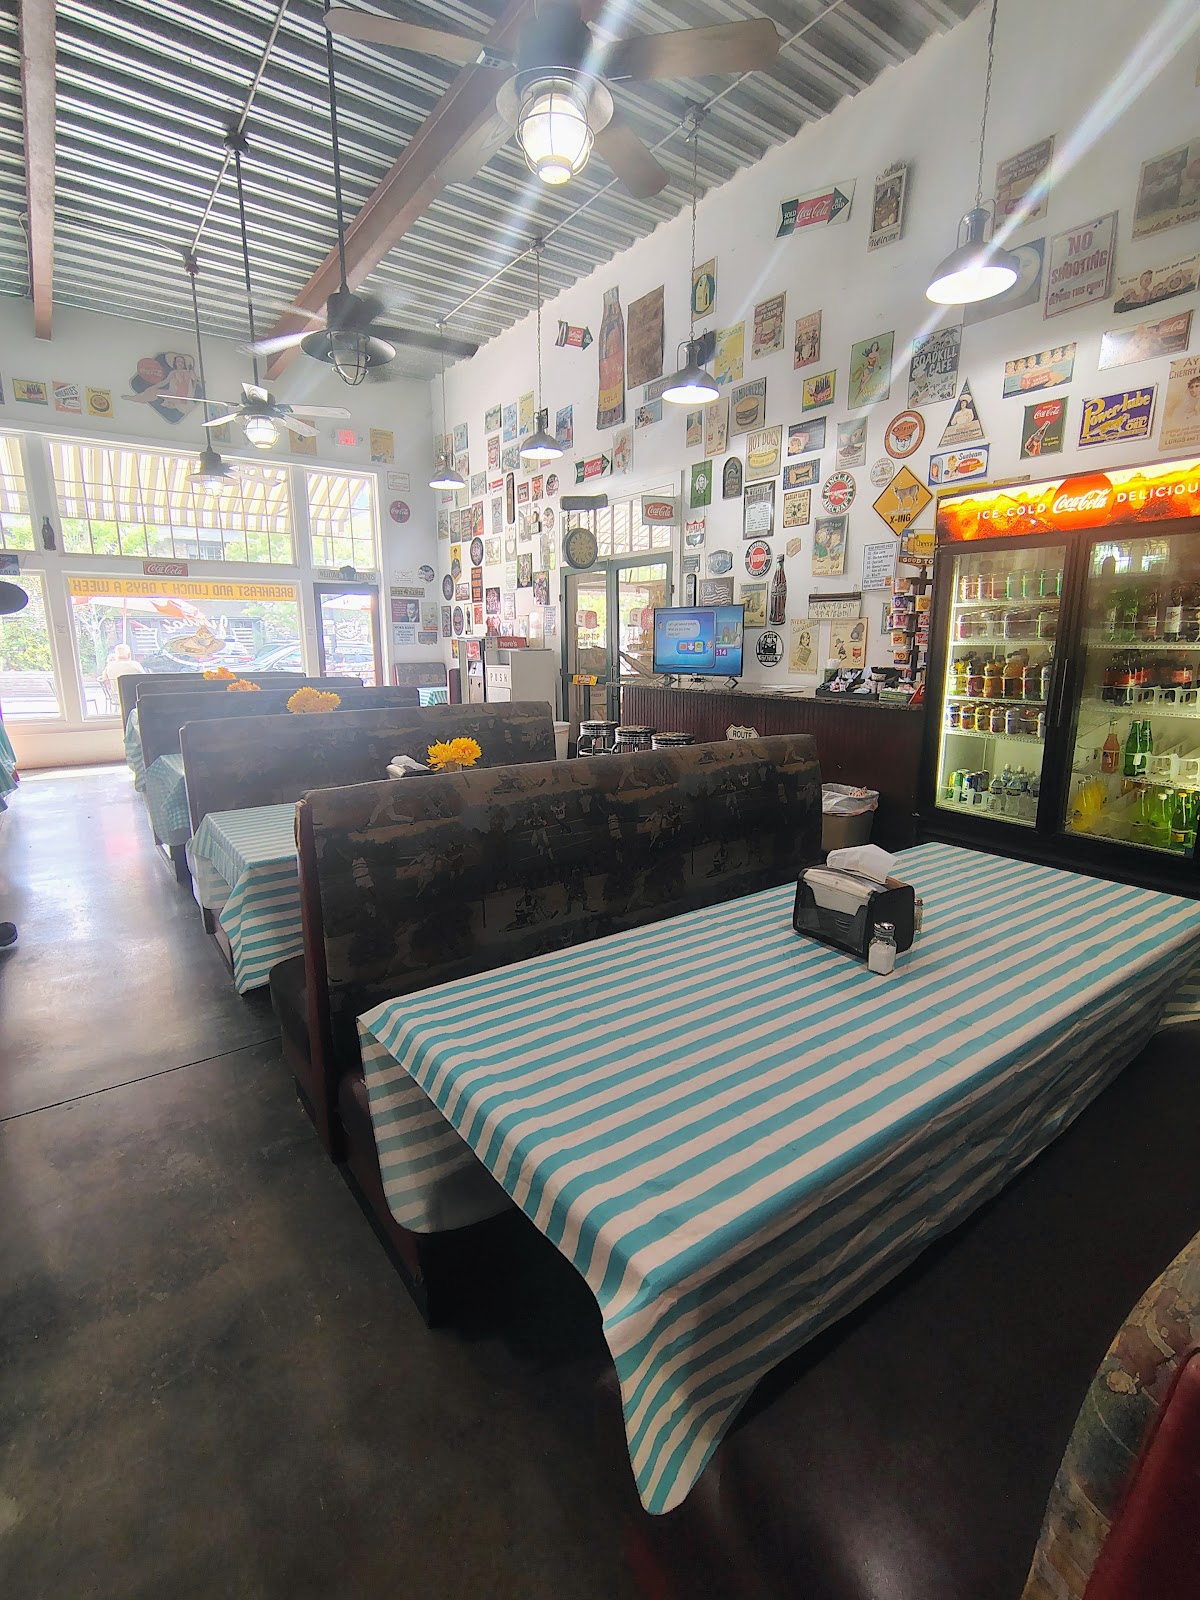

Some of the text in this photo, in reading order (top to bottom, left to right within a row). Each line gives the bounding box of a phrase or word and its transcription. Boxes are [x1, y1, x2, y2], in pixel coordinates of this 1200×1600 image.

[784, 209, 797, 220] SOLD
[1068, 231, 1094, 256] NO
[1051, 250, 1109, 285] SHOOTING
[912, 345, 958, 369] ROADKILL
[929, 359, 952, 375] CAFE
[1169, 367, 1196, 380] CHERRY
[1125, 420, 1147, 430] OIL
[749, 432, 761, 452] HOT
[958, 451, 983, 461] Sunbeam
[824, 474, 854, 494] SINCLAIR
[823, 492, 853, 515] AIRCRAFT
[977, 508, 999, 520] ICE
[1006, 503, 1047, 518] COLD
[1052, 488, 1111, 514] Coca-Cola
[889, 513, 911, 525] X-ING
[490, 672, 508, 683] PUSH
[732, 729, 753, 739] ROUTE
